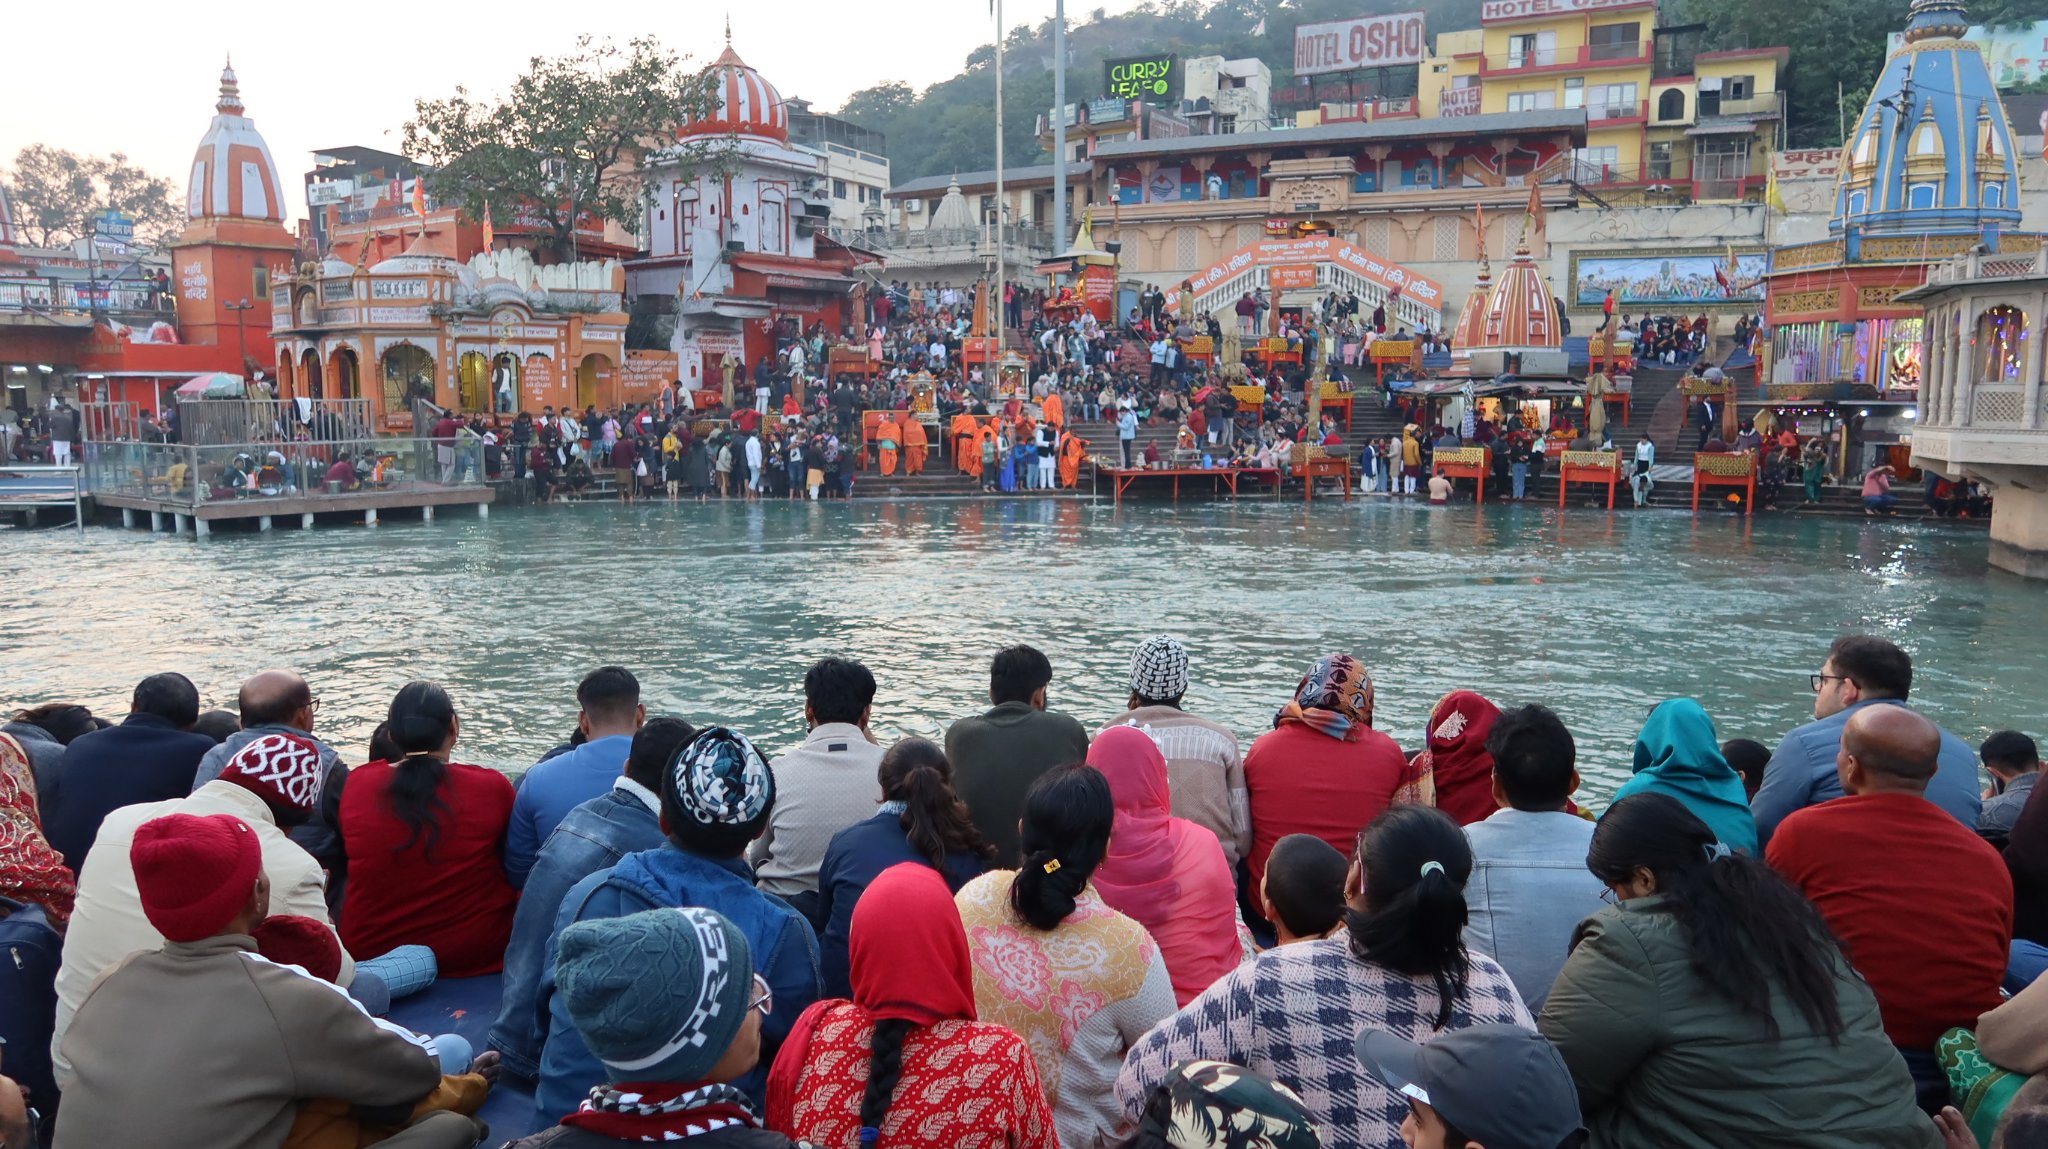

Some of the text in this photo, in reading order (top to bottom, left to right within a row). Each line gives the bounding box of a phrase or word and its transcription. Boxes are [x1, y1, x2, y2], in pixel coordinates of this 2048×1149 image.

[1485, 0, 1562, 17] HOTEL
[1297, 18, 1423, 68] HOTEL OSHO
[1111, 59, 1170, 81] CURRY
